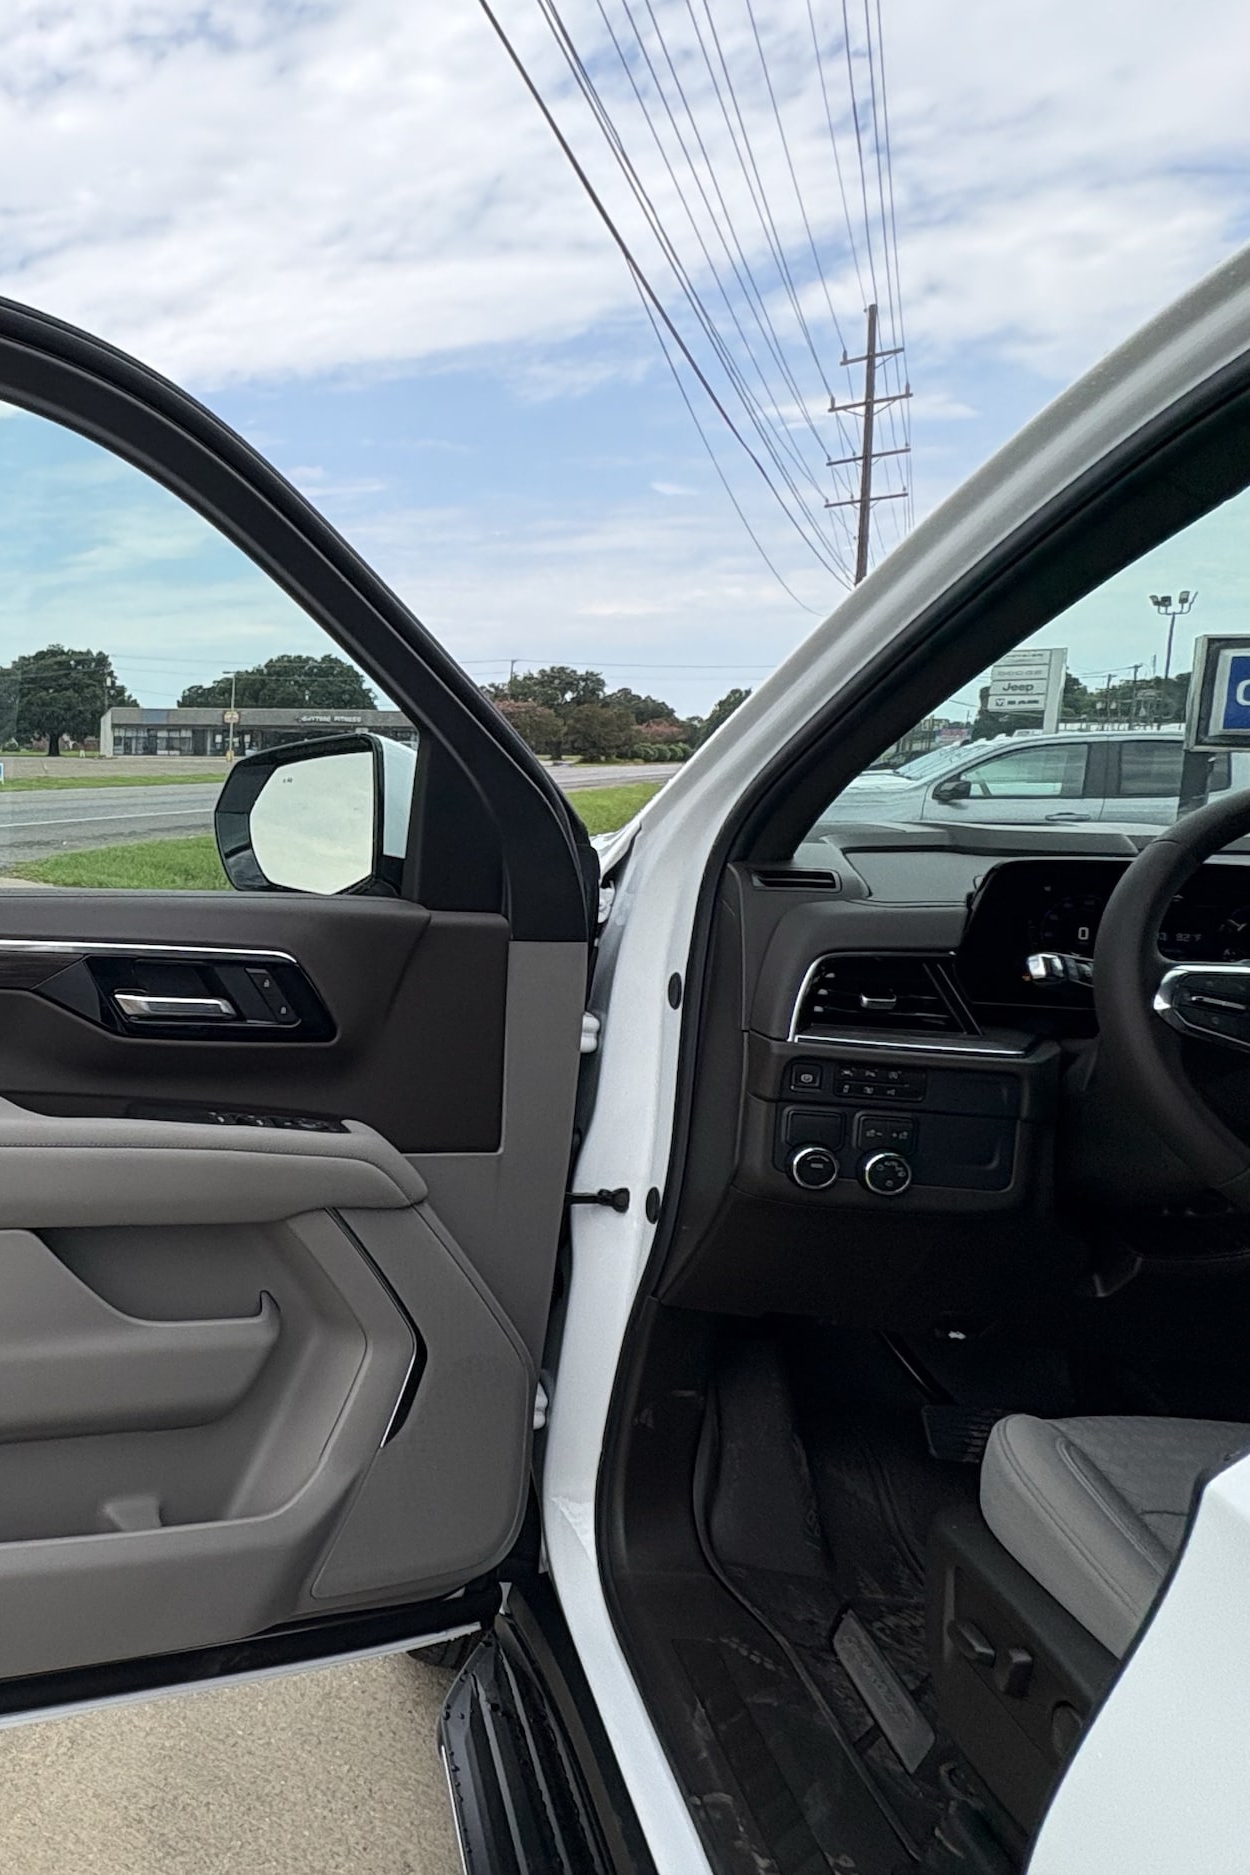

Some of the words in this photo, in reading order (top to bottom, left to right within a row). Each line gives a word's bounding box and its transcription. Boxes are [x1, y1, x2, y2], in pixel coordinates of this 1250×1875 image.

[1002, 683, 1035, 692] Jeep
[334, 715, 362, 723] FITNESS
[1078, 926, 1090, 941] 0
